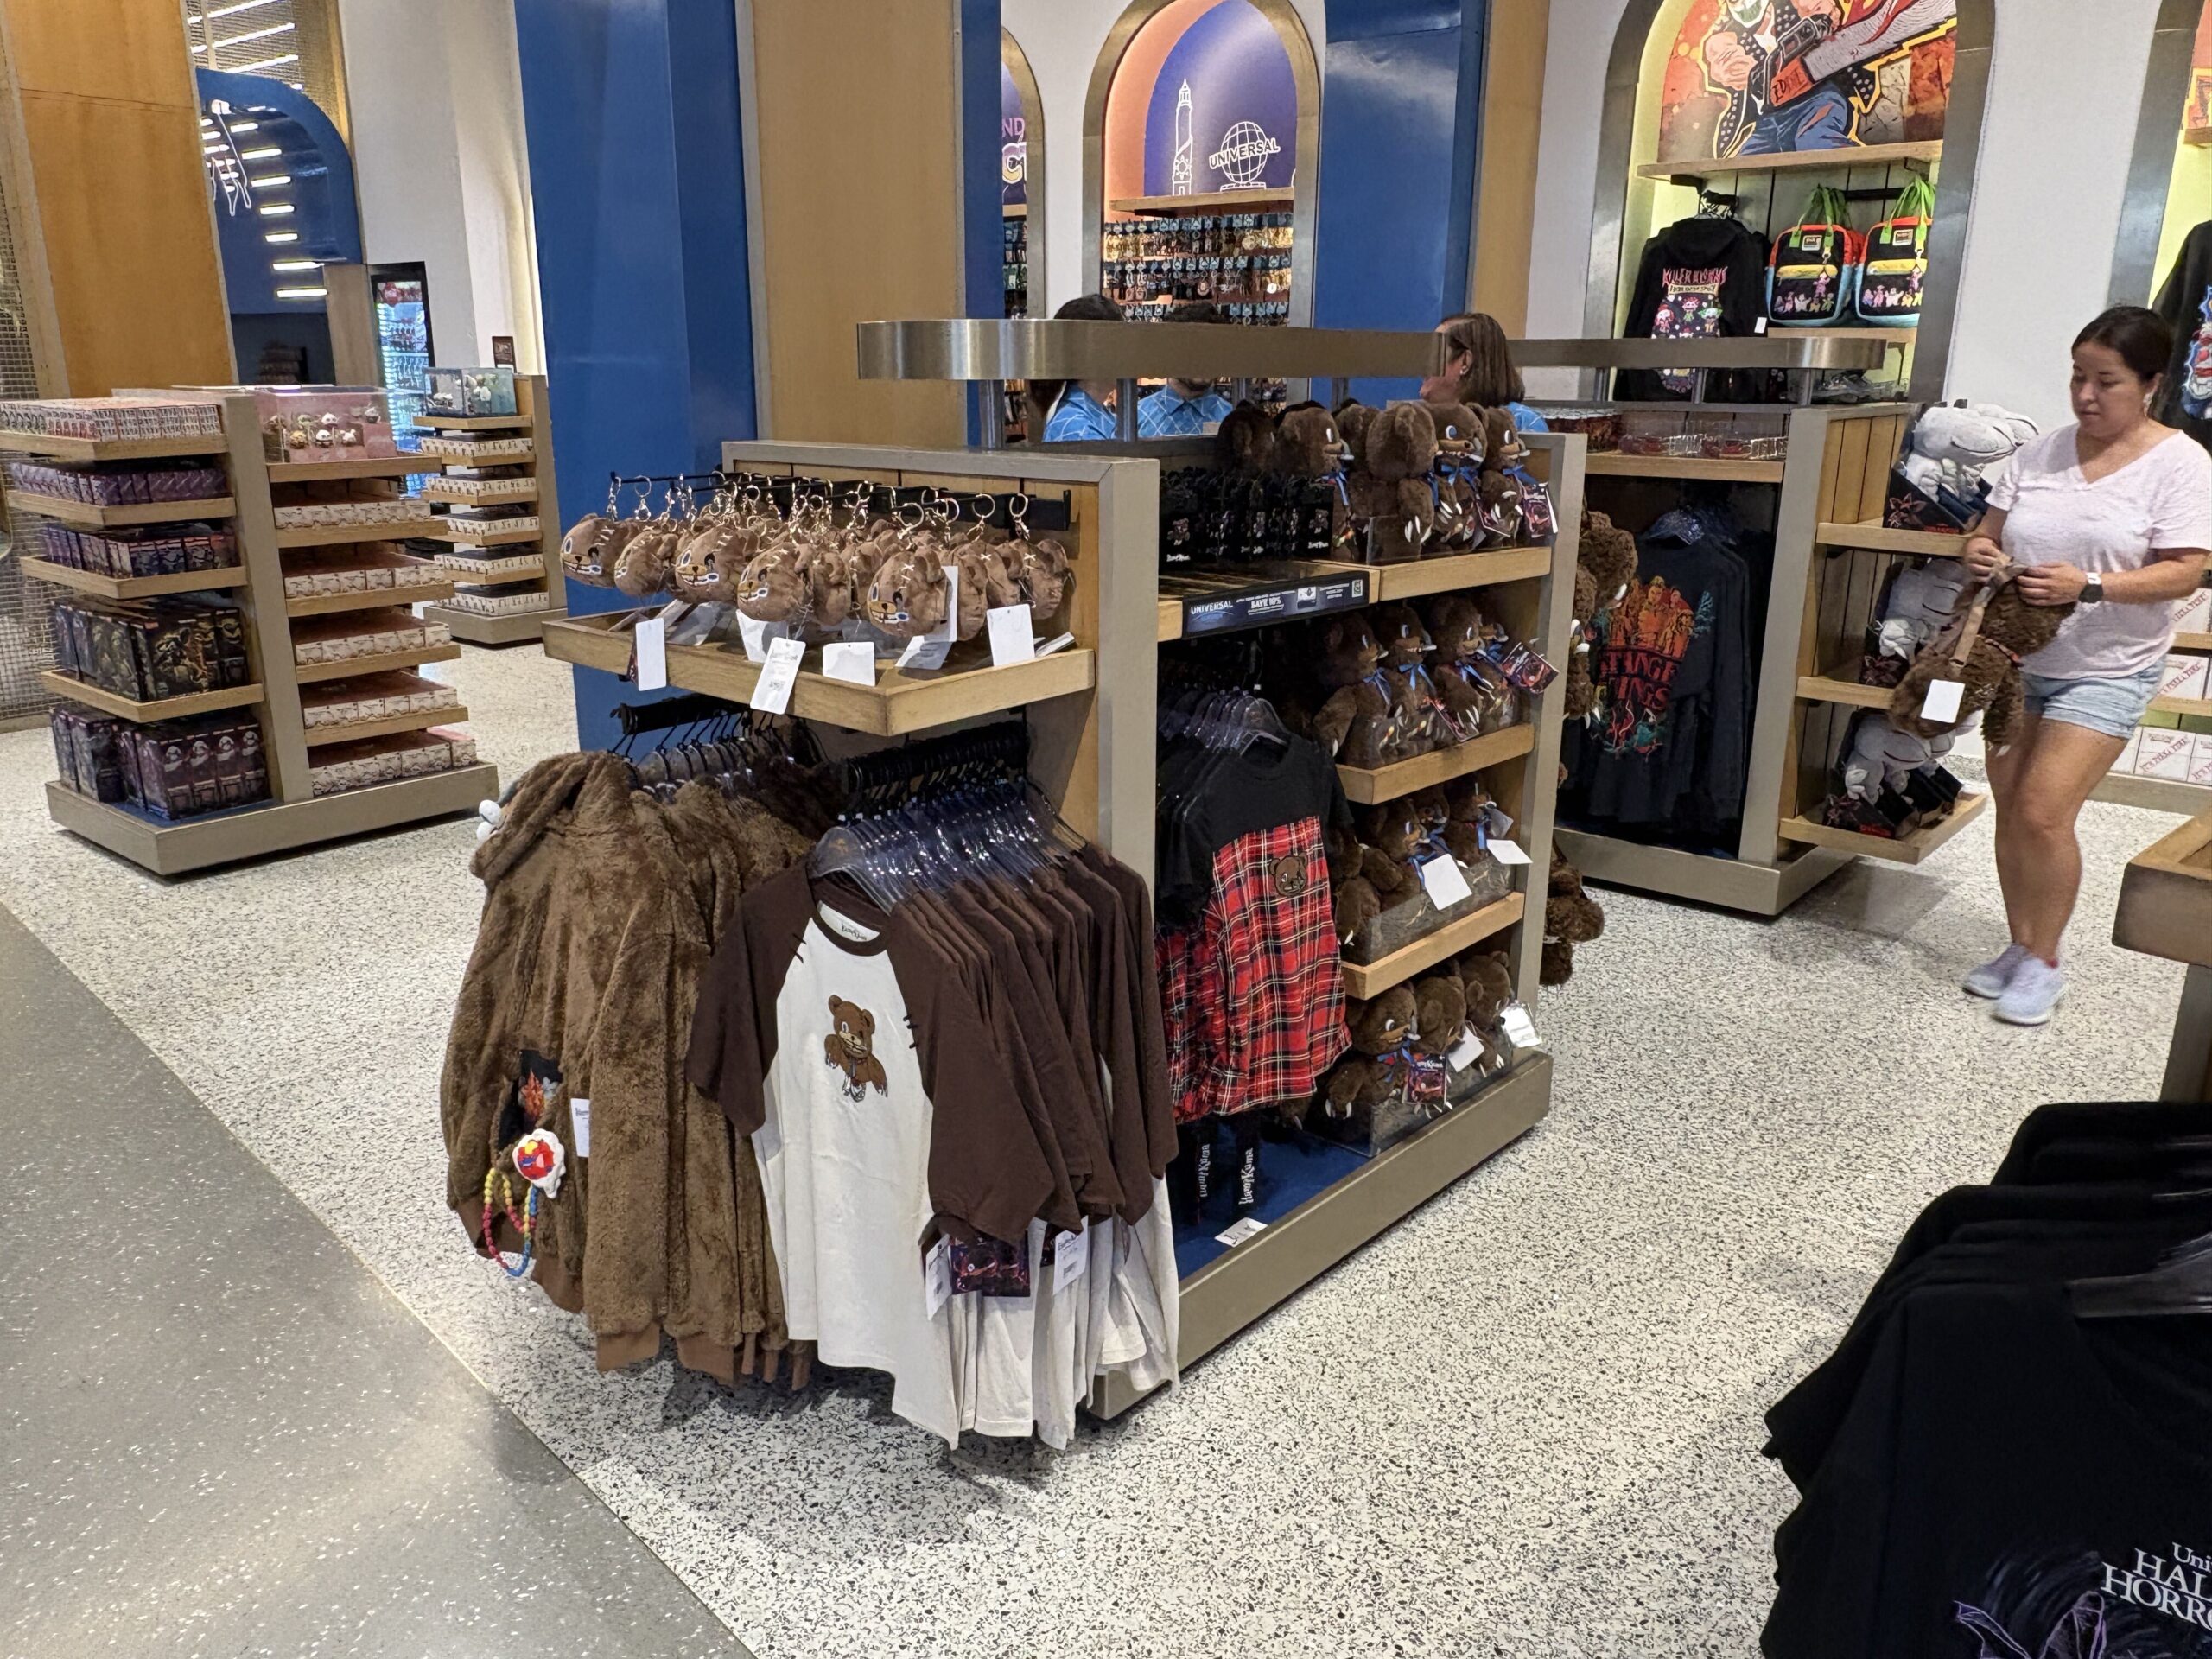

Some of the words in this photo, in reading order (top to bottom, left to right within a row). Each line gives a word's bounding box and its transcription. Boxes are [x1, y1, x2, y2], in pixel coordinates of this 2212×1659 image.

[1209, 137, 1281, 169] UNIVERSAL
[1190, 600, 1233, 614] UNIVERSAL
[2171, 1541, 2212, 1573] Uni
[2132, 1548, 2212, 1603] HAL
